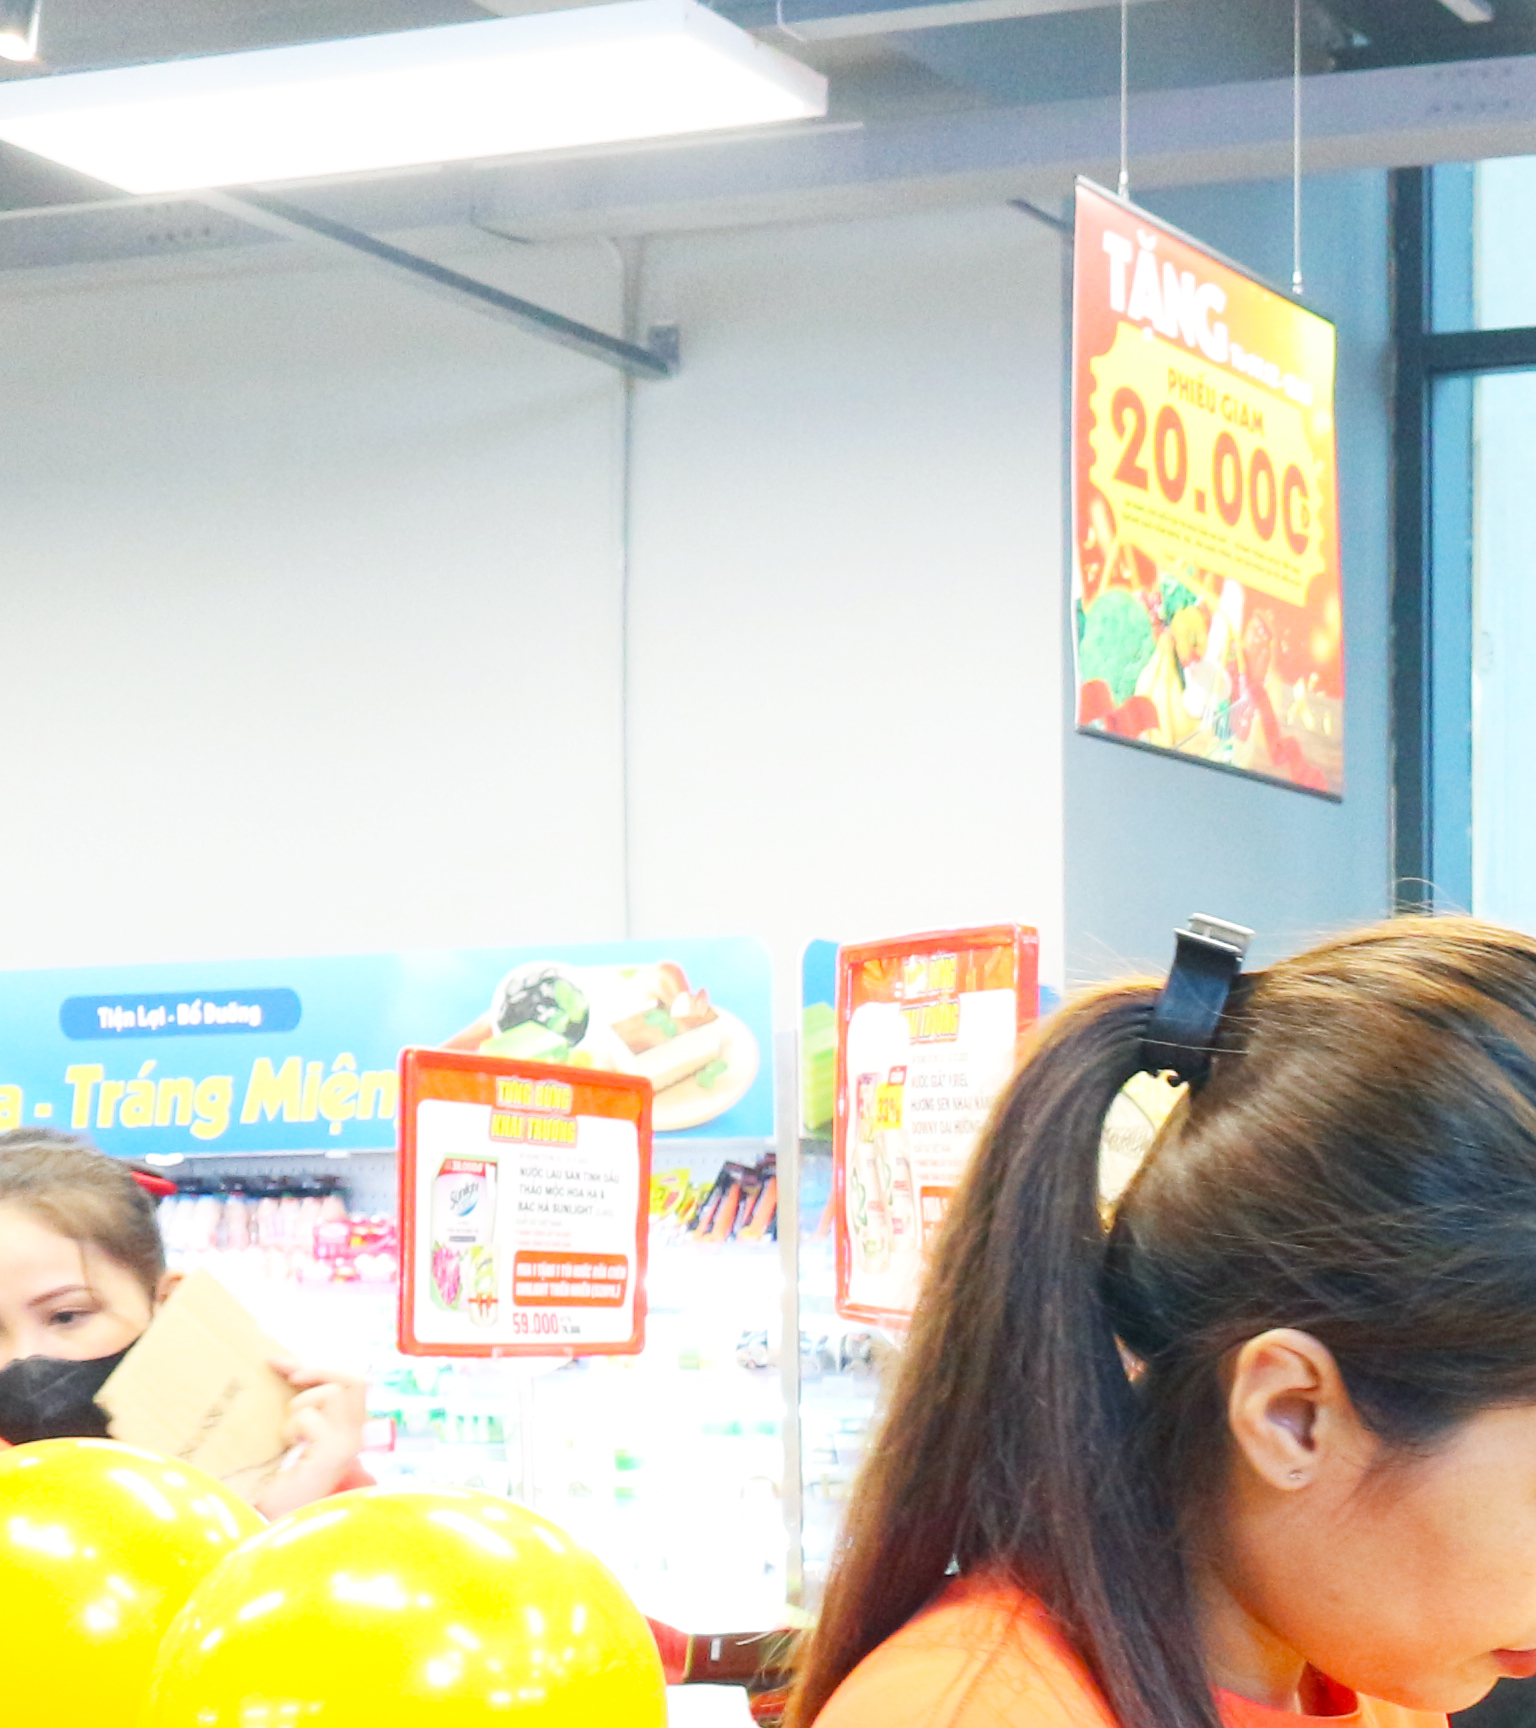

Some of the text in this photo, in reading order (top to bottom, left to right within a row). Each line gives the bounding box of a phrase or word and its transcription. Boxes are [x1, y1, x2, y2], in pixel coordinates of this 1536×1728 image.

[1102, 228, 1228, 363] TẶNG
[66, 1060, 233, 1141] Tráng
[240, 1052, 399, 1137] Miện
[546, 1168, 562, 1180] LAU
[553, 1203, 594, 1216] SUNLIGHT
[513, 1312, 559, 1335] 59.000
